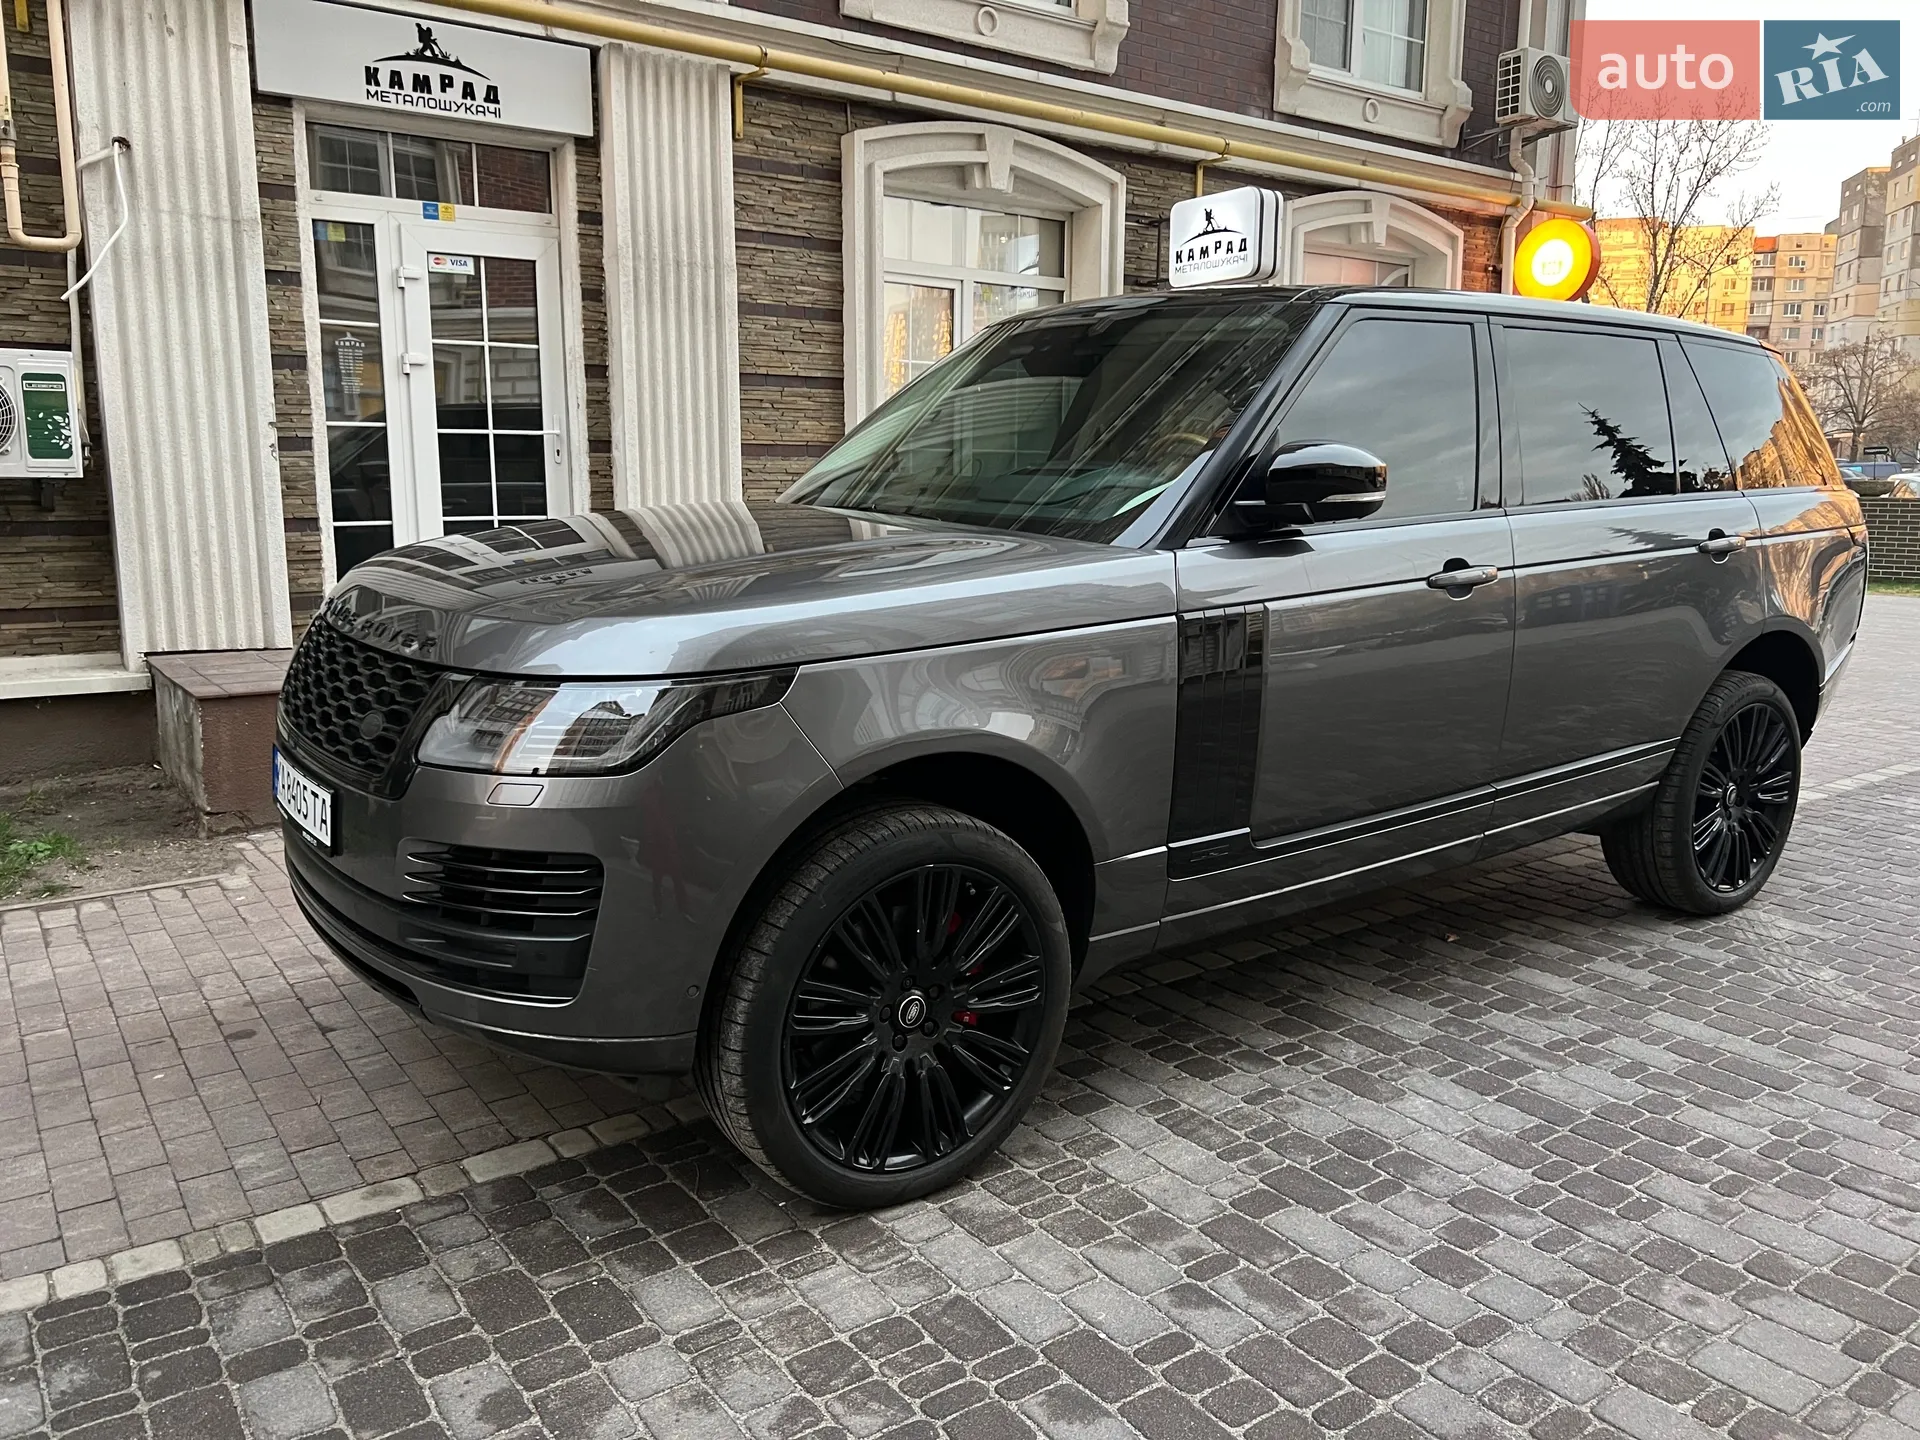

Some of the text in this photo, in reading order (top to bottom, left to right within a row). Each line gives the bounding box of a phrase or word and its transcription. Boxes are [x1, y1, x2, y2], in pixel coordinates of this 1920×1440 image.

[364, 65, 501, 105] КАМРАД
[366, 88, 501, 118] МЕТАЛОШУКАЧІ
[449, 258, 468, 267] VISA
[1175, 254, 1248, 274] МЕТАЛОШУКАЧІ
[1176, 238, 1247, 264] КАМРАД
